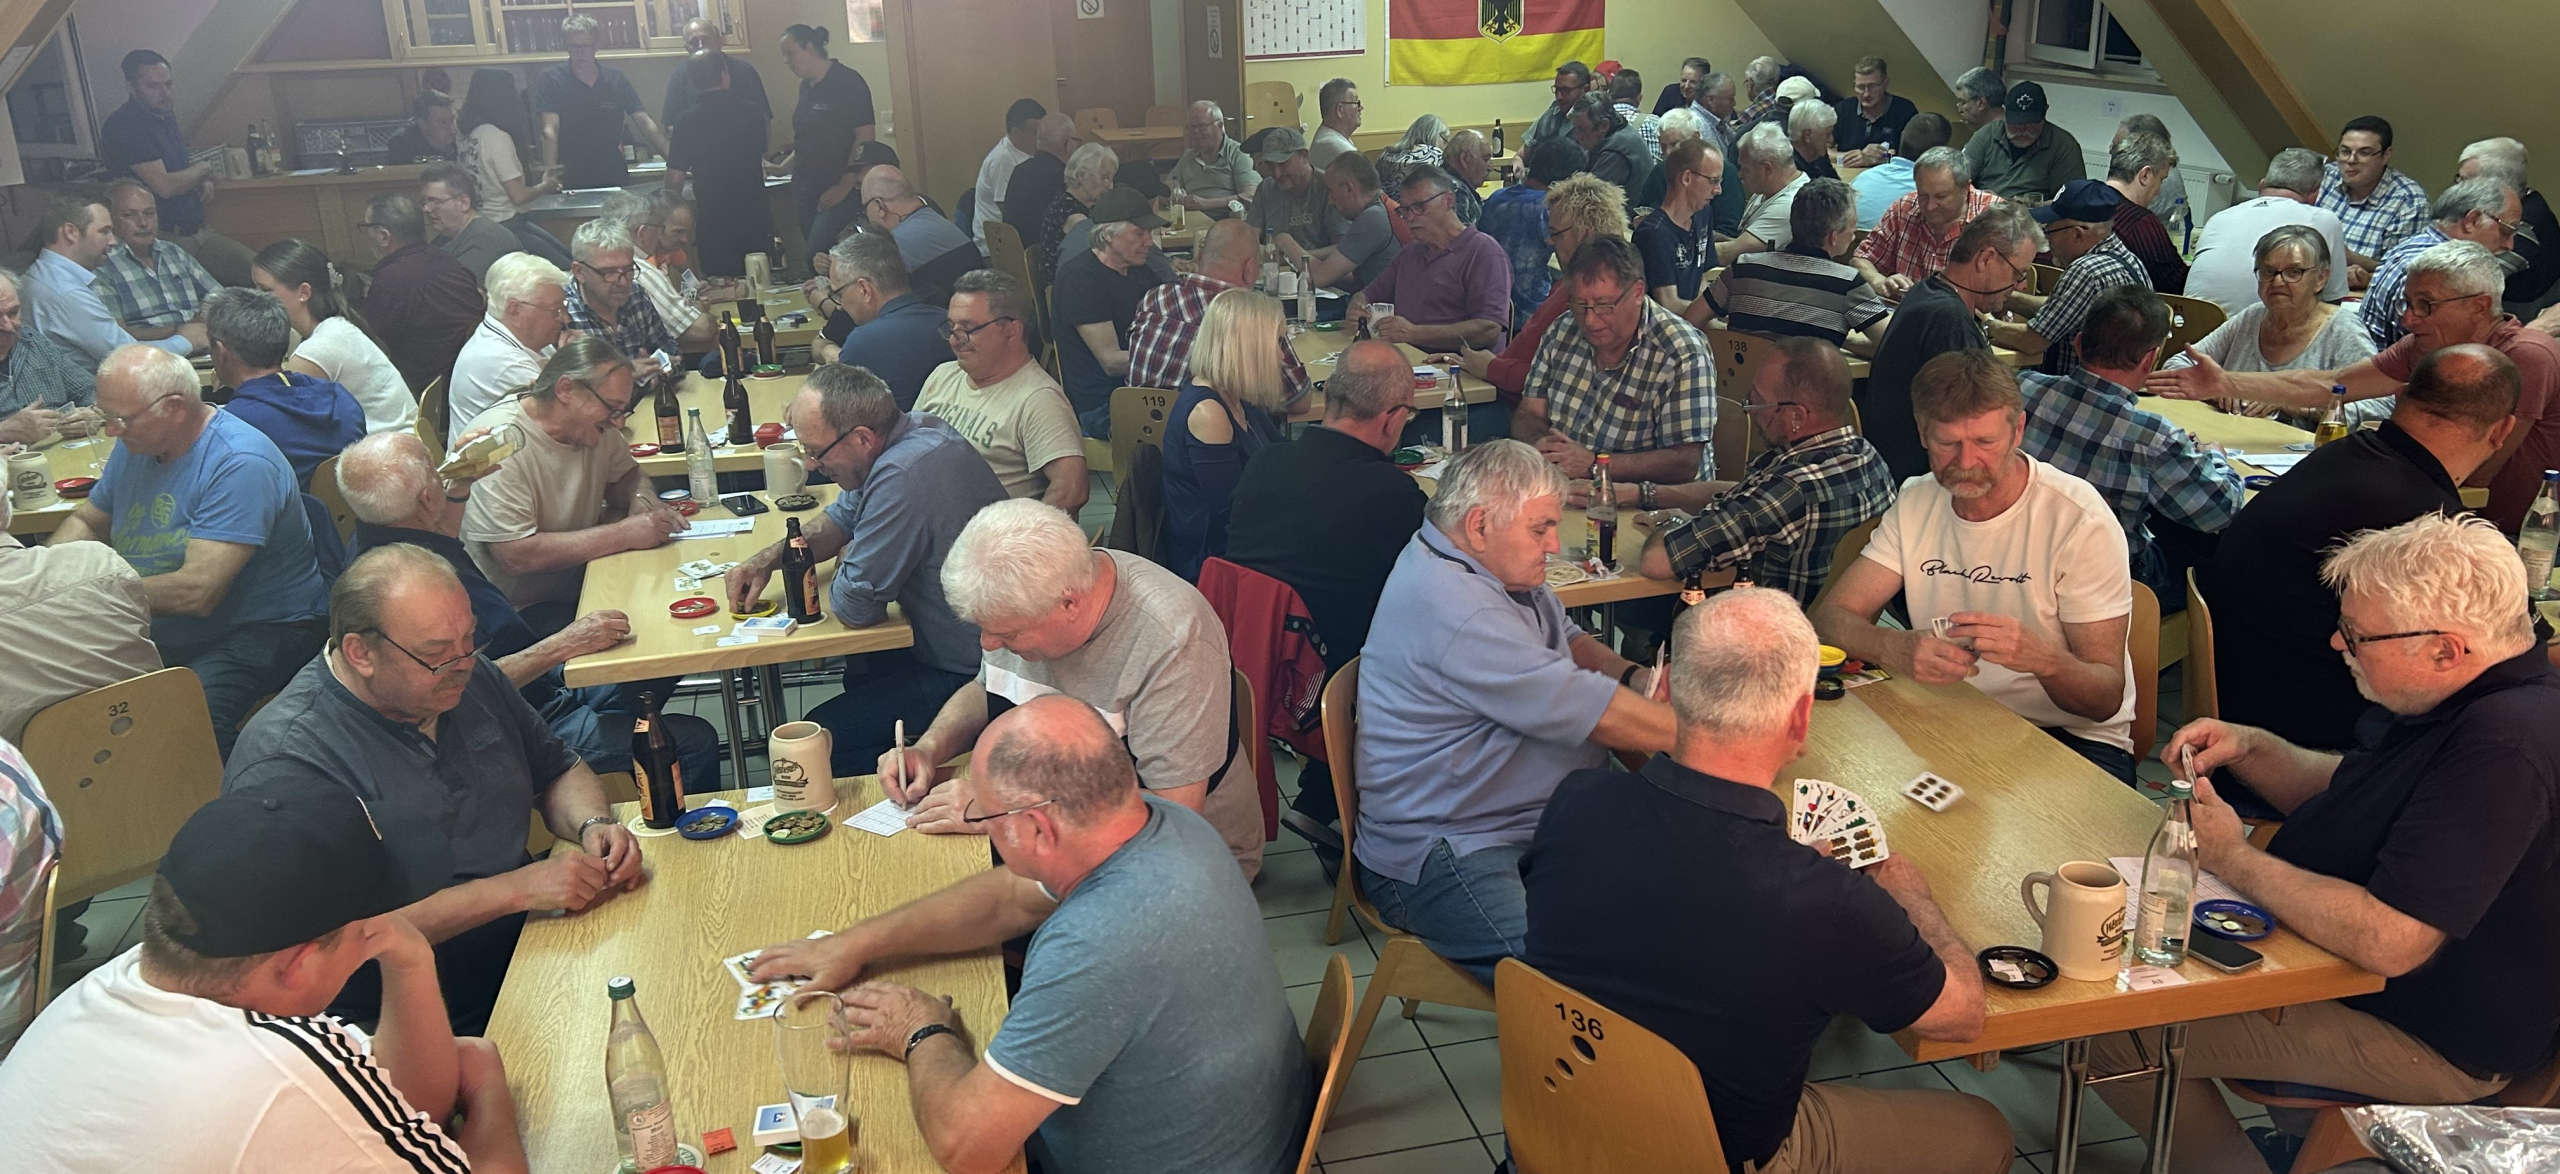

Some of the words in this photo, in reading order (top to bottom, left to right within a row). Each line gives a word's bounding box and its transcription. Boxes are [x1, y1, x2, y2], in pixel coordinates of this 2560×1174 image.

[1728, 340, 1747, 352] 138
[1142, 395, 1166, 407] 119
[931, 402, 998, 449] IGINALS
[1920, 559, 1971, 579] Black
[1969, 565, 2031, 583] Revolt
[108, 701, 130, 717] 32
[1555, 1002, 1604, 1041] 136
